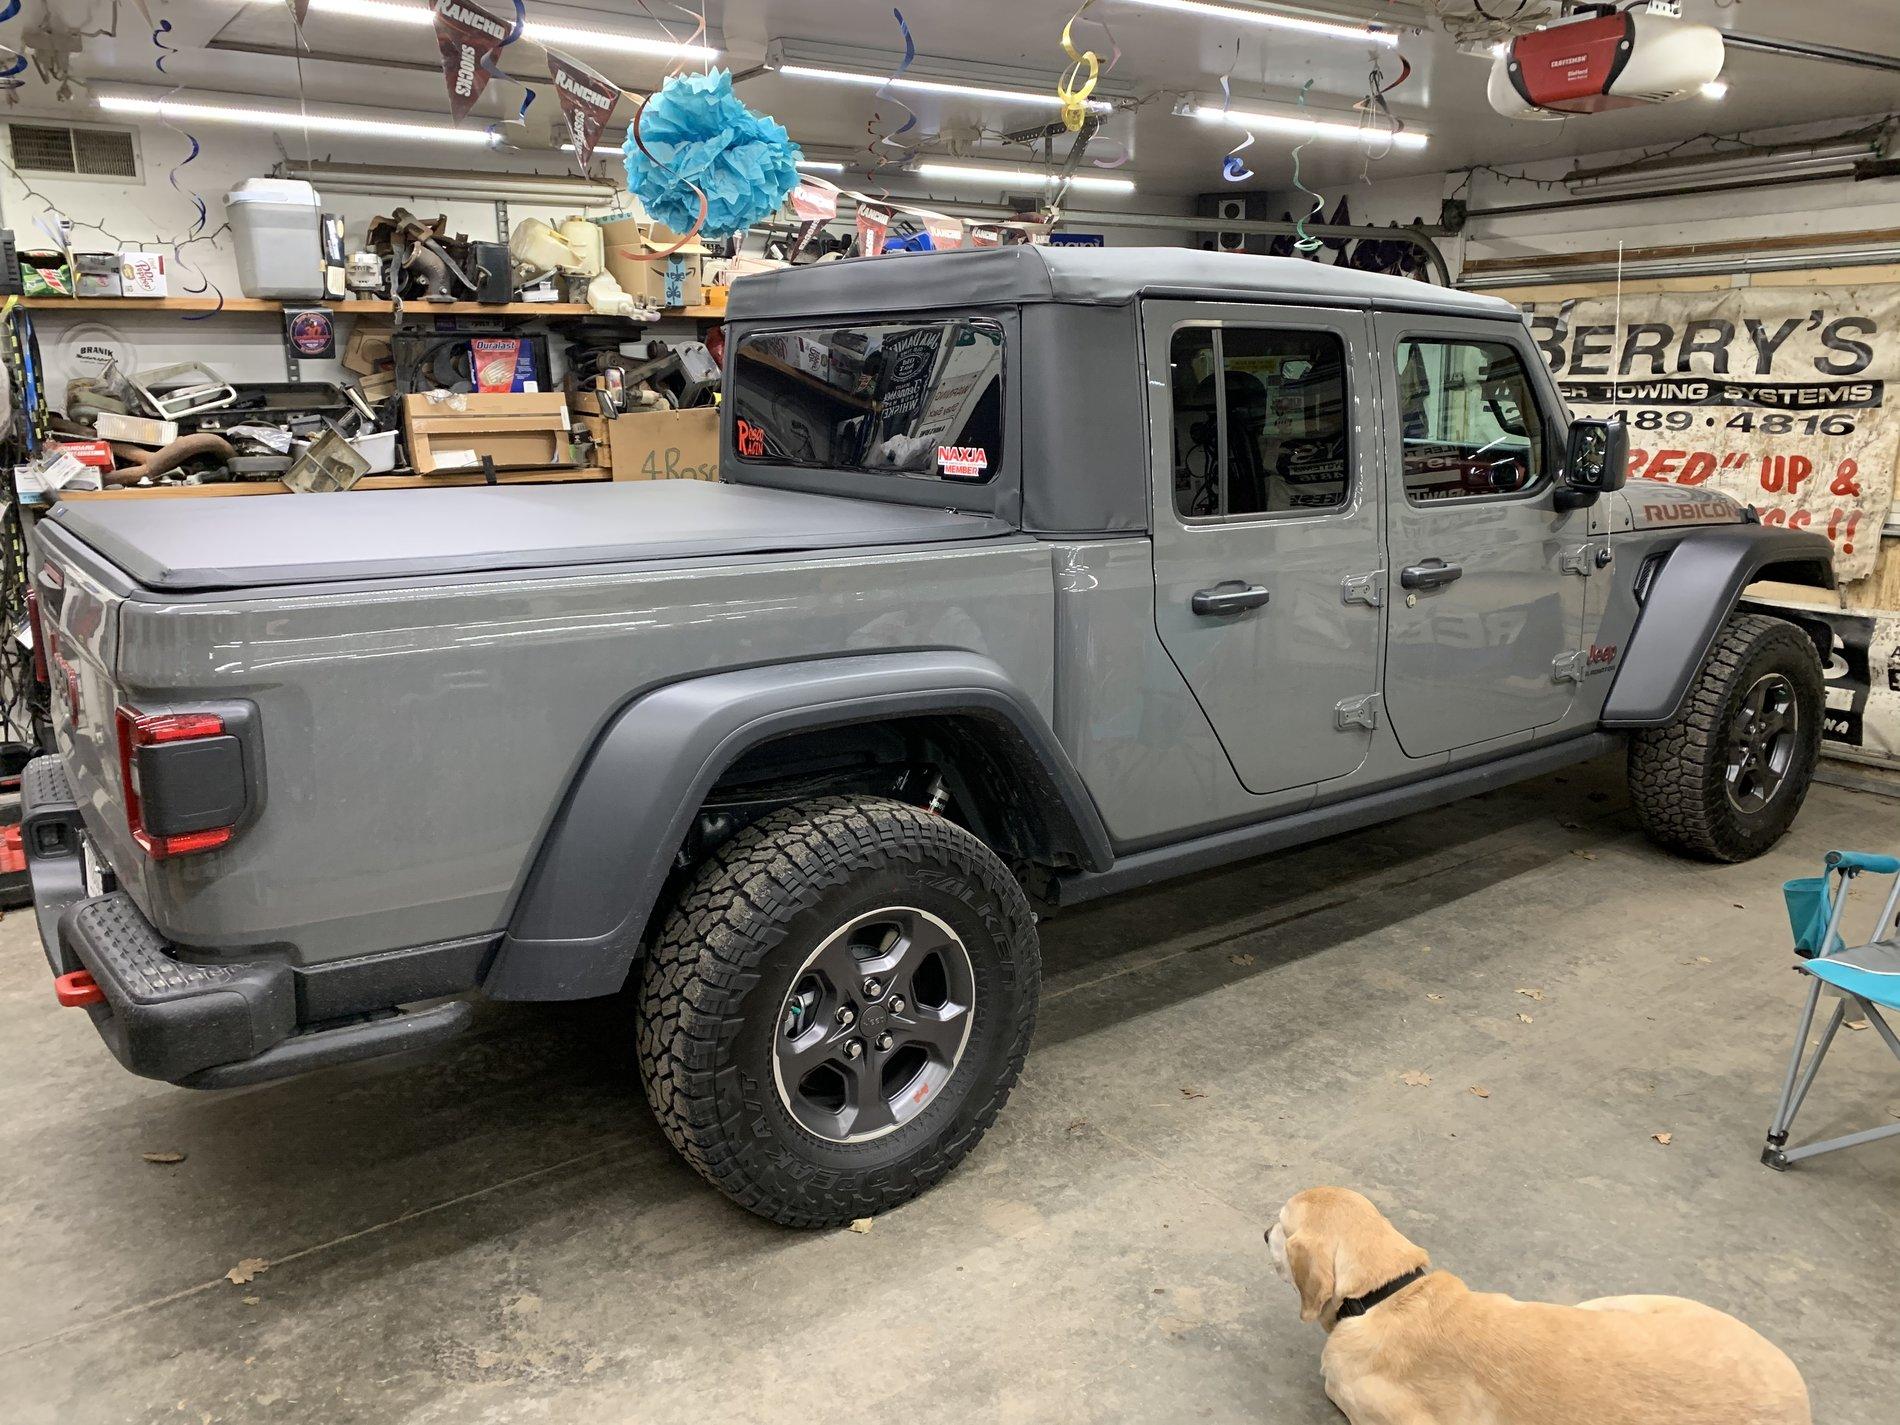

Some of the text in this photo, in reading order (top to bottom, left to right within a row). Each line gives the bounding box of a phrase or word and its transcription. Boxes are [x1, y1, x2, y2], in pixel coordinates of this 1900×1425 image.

[436, 0, 506, 40] RANCHO
[455, 44, 476, 97] SHOCKS
[554, 69, 612, 110] RANCHO
[80, 346, 113, 357] BRANIK
[476, 341, 515, 350] Duralast
[1600, 383, 1709, 400] TOWING
[1723, 383, 1874, 405] SYSTEMS
[938, 446, 987, 463] NAXJA
[945, 464, 979, 476] MEMBER
[1760, 455, 1813, 494] UP
[1829, 458, 1861, 498] &
[1644, 502, 1740, 522] RUBICON
[1587, 645, 1617, 666] Jeep
